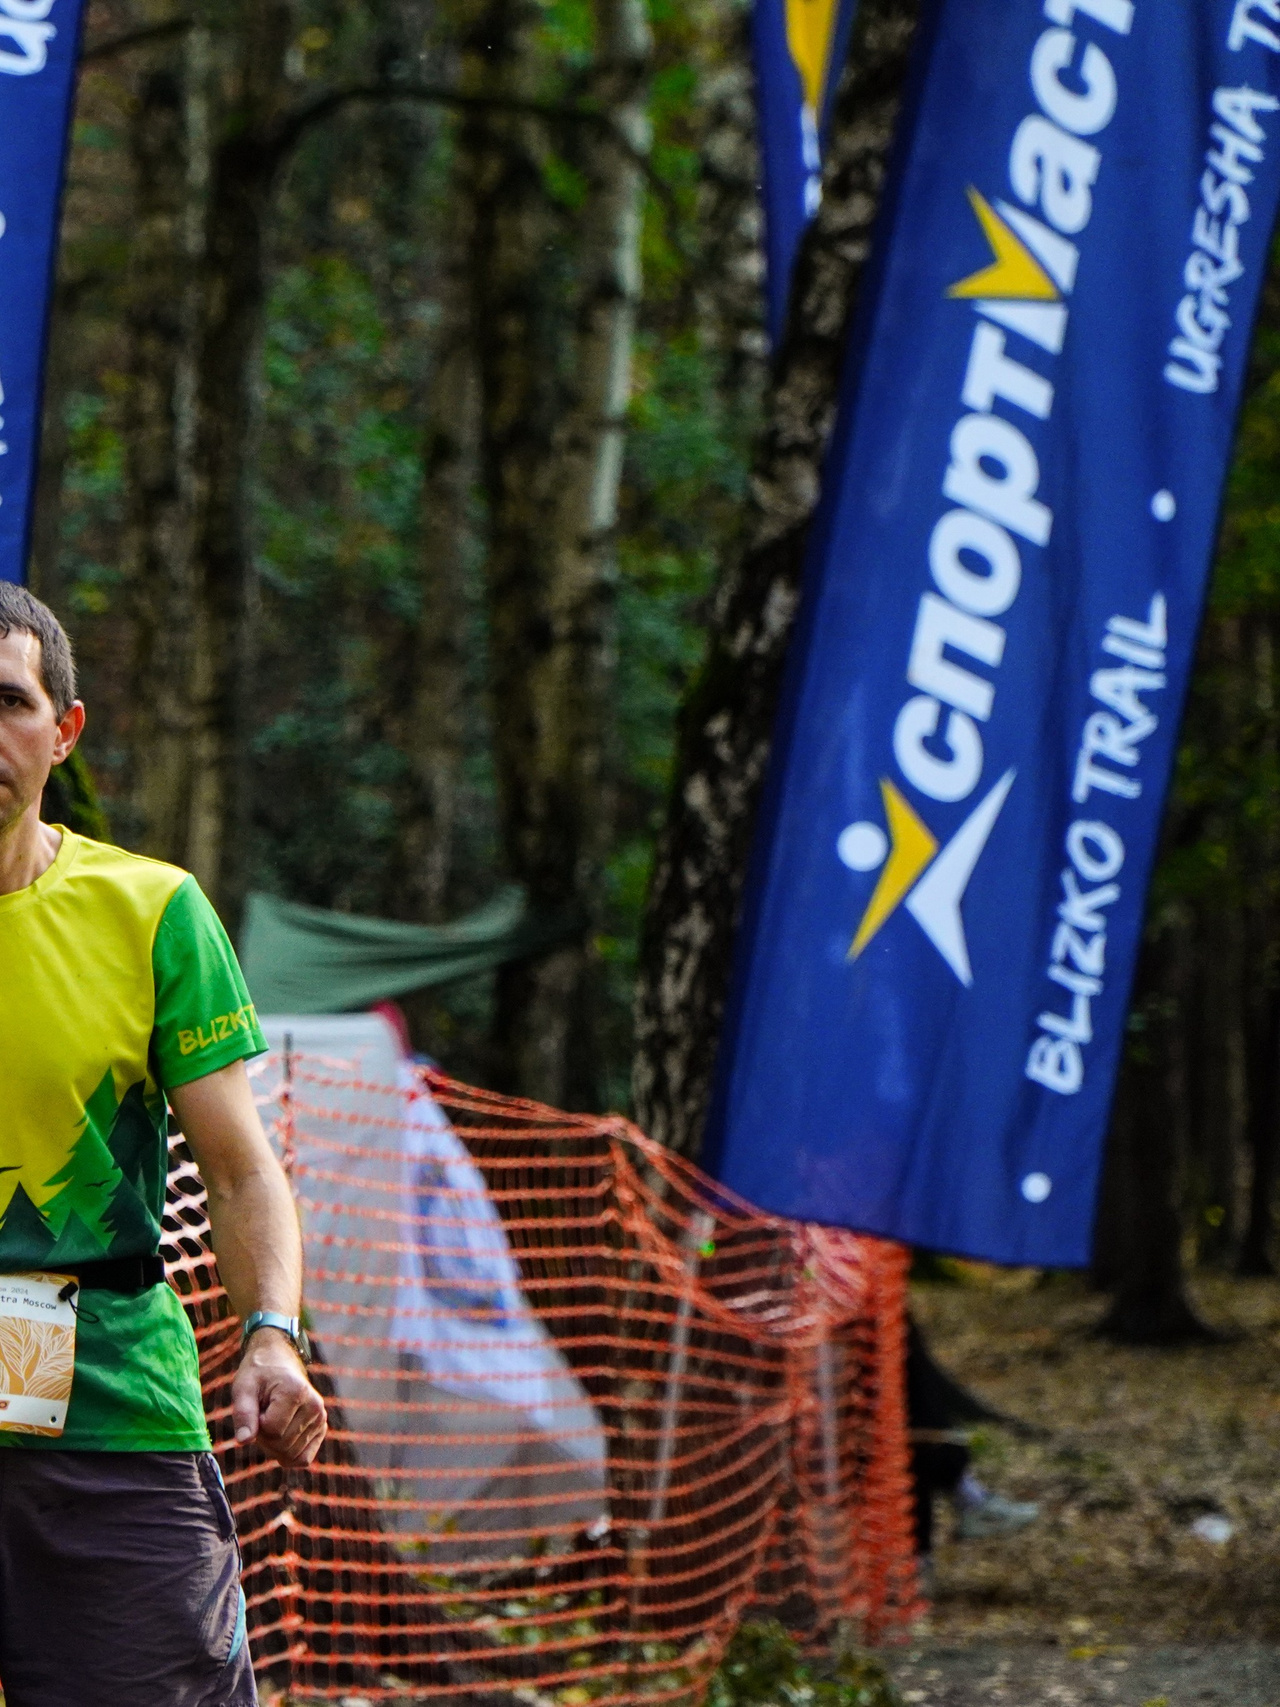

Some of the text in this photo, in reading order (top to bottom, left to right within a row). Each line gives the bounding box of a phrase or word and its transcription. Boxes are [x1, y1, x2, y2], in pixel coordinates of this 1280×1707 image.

[1165, 84, 1280, 393] UGRESHA
[1073, 592, 1168, 802] TRAIL
[1024, 818, 1126, 1096] BLIZKO
[11, 1286, 29, 1295] 2024
[23, 1297, 58, 1311] Moscow
